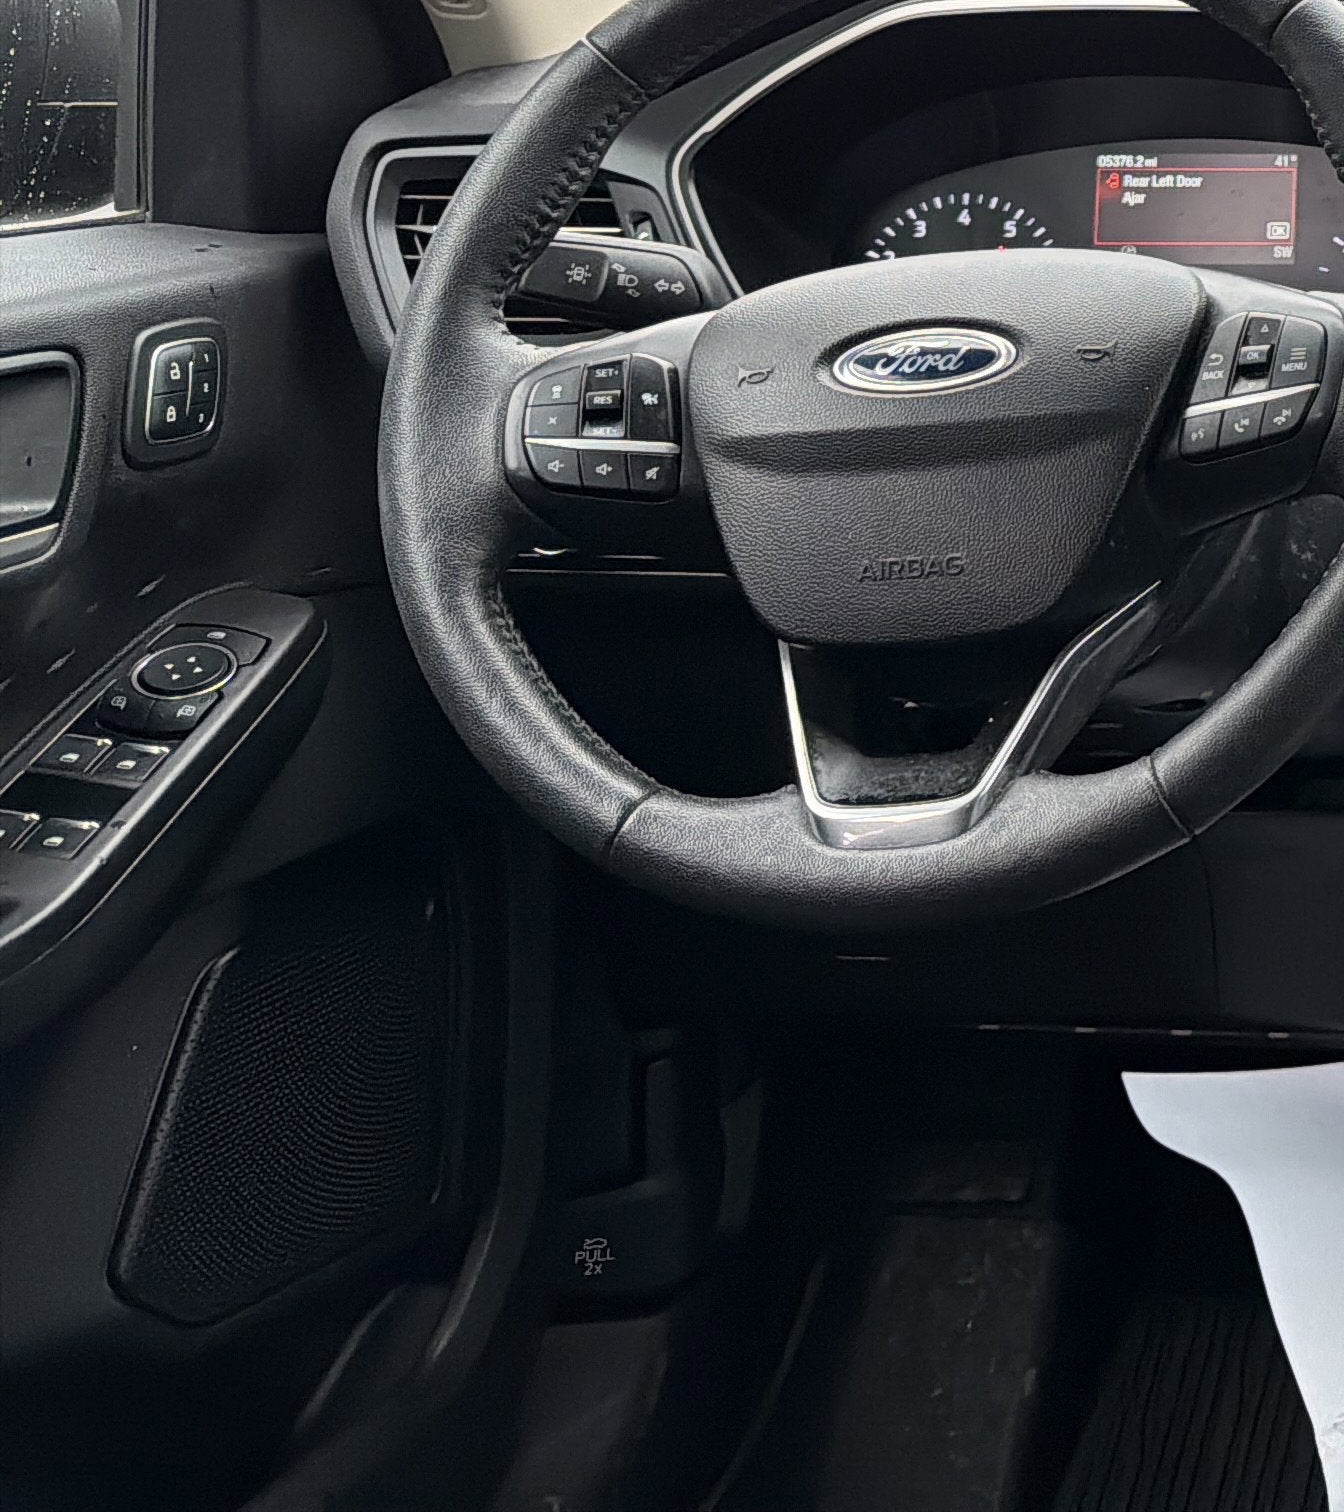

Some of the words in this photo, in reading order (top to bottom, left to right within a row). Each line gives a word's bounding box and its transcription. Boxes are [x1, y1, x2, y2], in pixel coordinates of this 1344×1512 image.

[1122, 174, 1149, 189] Rear
[1151, 174, 1174, 189] Left
[1175, 175, 1203, 189] Door
[1121, 191, 1146, 207] Ajar
[957, 208, 972, 226] 4
[912, 220, 928, 238] 3
[1002, 220, 1018, 238] 5
[1270, 223, 1287, 237] OK
[1272, 245, 1294, 259] SW
[875, 339, 969, 376] Ford
[1246, 351, 1260, 361] OK
[1281, 361, 1308, 373] MENU
[1201, 369, 1224, 381] BACK
[592, 395, 613, 406] RES
[859, 553, 967, 583] AIRBAG
[575, 1247, 616, 1265] PULL
